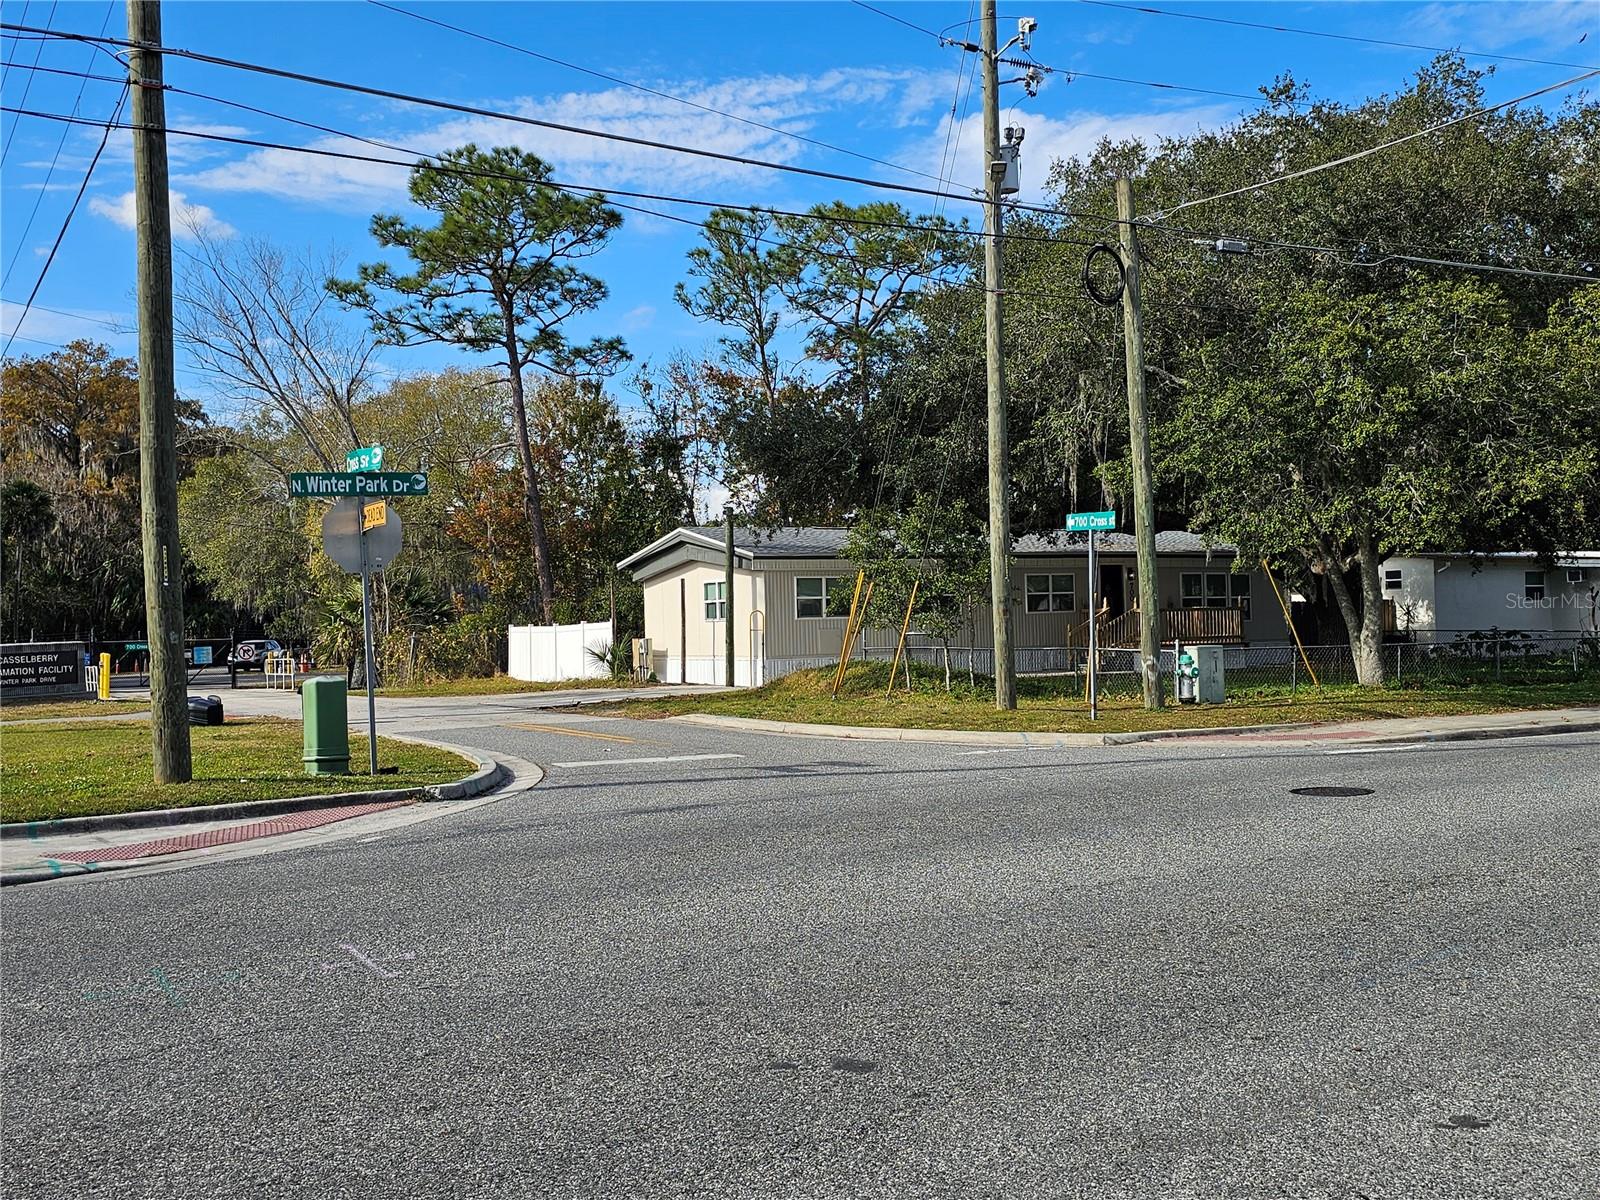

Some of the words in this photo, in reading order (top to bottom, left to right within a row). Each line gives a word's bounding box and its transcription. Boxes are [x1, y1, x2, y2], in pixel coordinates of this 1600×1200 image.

[360, 455, 369, 468] St
[292, 480, 305, 493] N.
[305, 475, 352, 493] Winter
[355, 475, 388, 493] Park
[393, 481, 409, 493] Dr
[1074, 516, 1088, 527] 700
[1089, 515, 1107, 527] Cross
[39, 665, 74, 674] FACILITY
